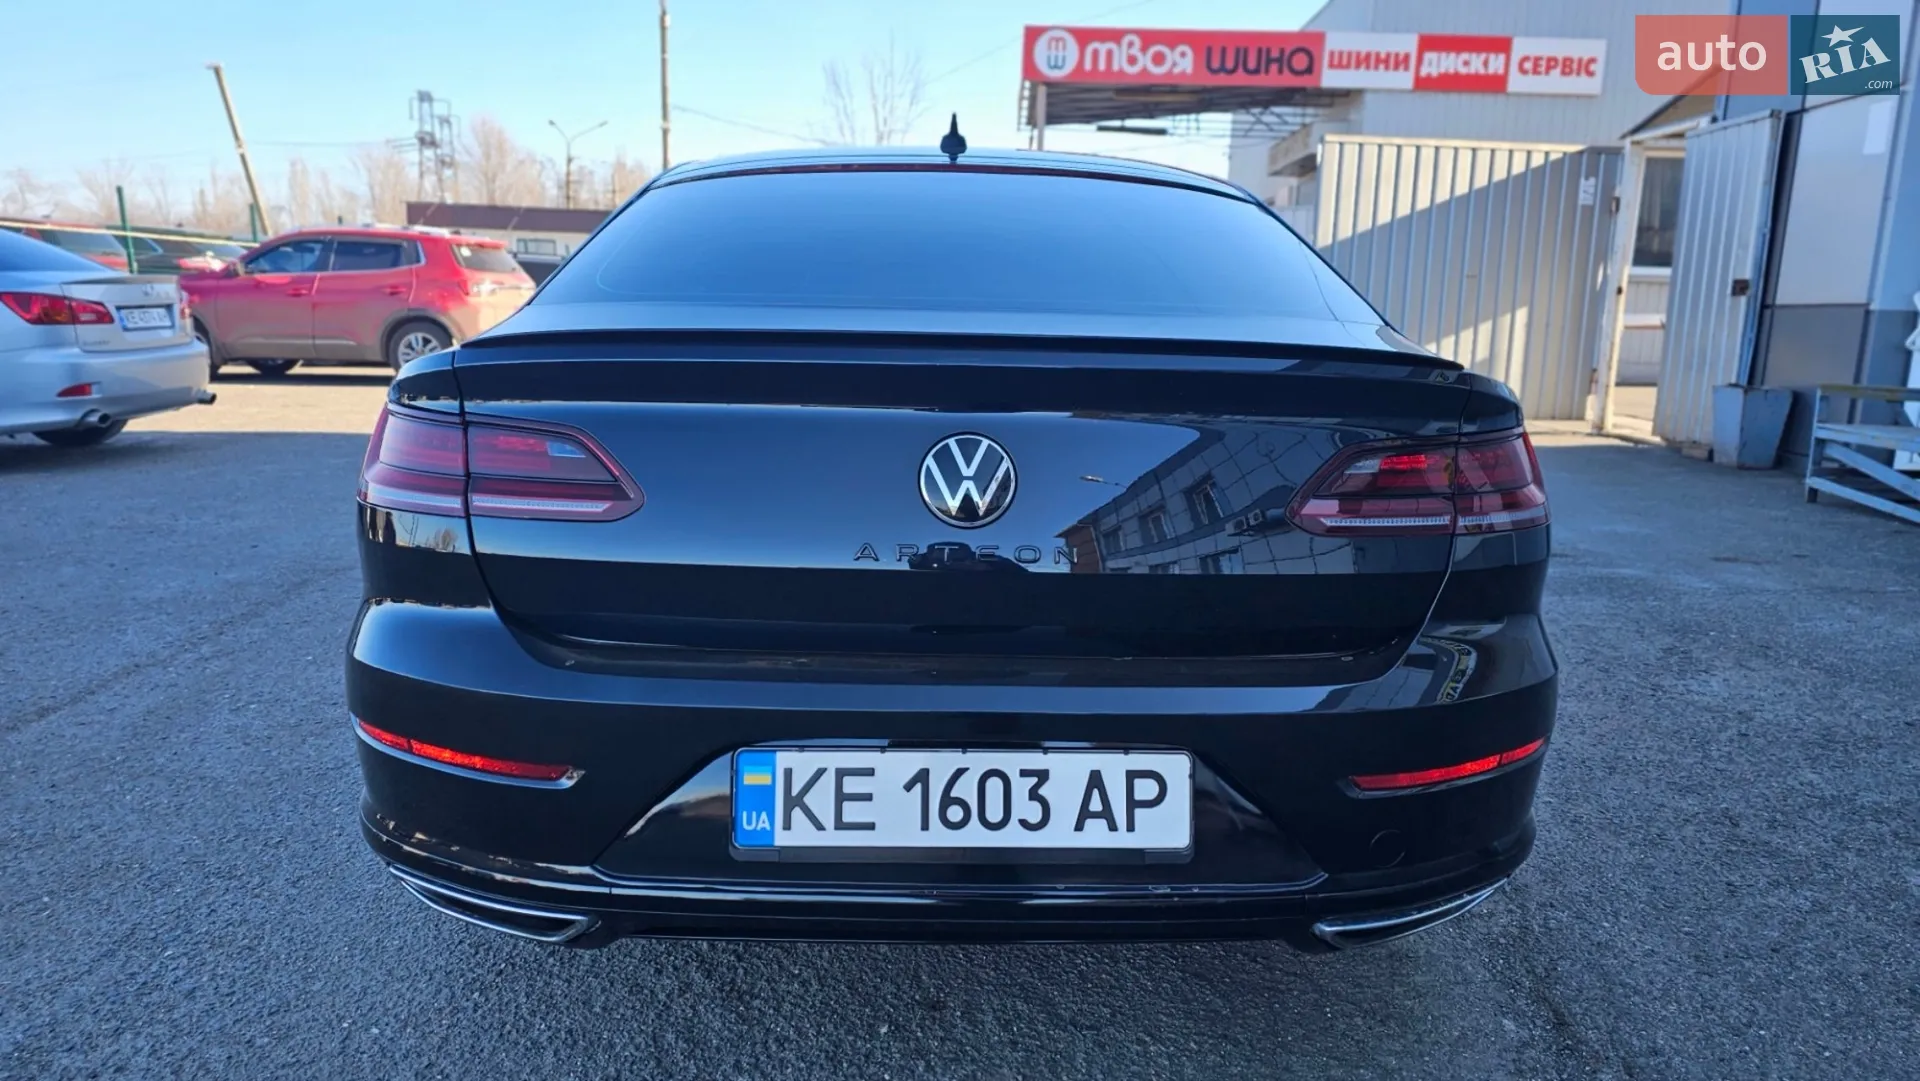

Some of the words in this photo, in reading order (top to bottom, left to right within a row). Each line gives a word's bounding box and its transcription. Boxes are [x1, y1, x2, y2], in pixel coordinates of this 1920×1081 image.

[1327, 51, 1411, 72] ШИНИ
[1419, 51, 1506, 77] ДИСКИ
[1518, 55, 1599, 77] СЕРВІС
[853, 543, 1078, 565] ARTEON
[782, 767, 876, 831] KE
[902, 768, 1051, 832] 1603
[1073, 769, 1168, 832] AP
[742, 811, 771, 831] UA
